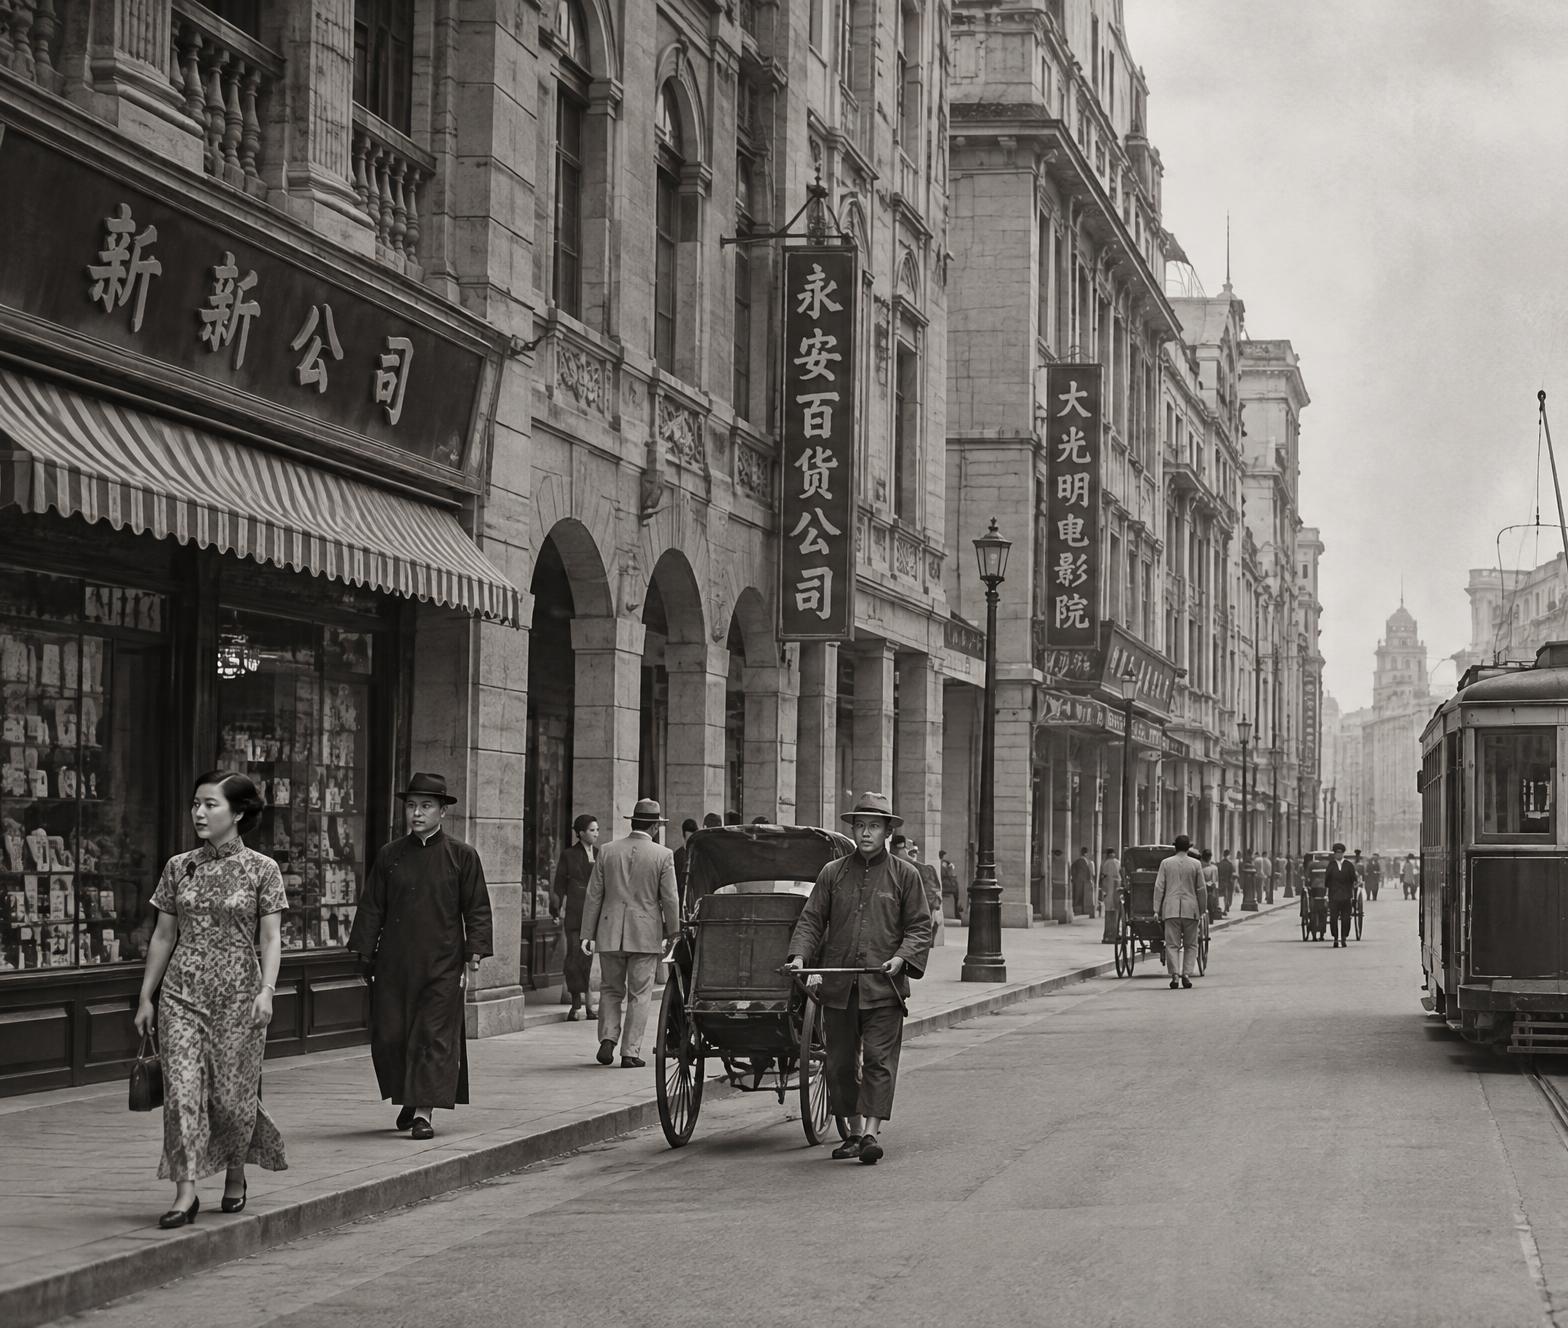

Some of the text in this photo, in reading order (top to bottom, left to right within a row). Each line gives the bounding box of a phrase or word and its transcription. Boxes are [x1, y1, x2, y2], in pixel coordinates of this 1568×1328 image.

[87, 203, 414, 425] 新新公司
[789, 263, 844, 620] 永安百货公司
[1054, 380, 1092, 629] 大光明电影院
